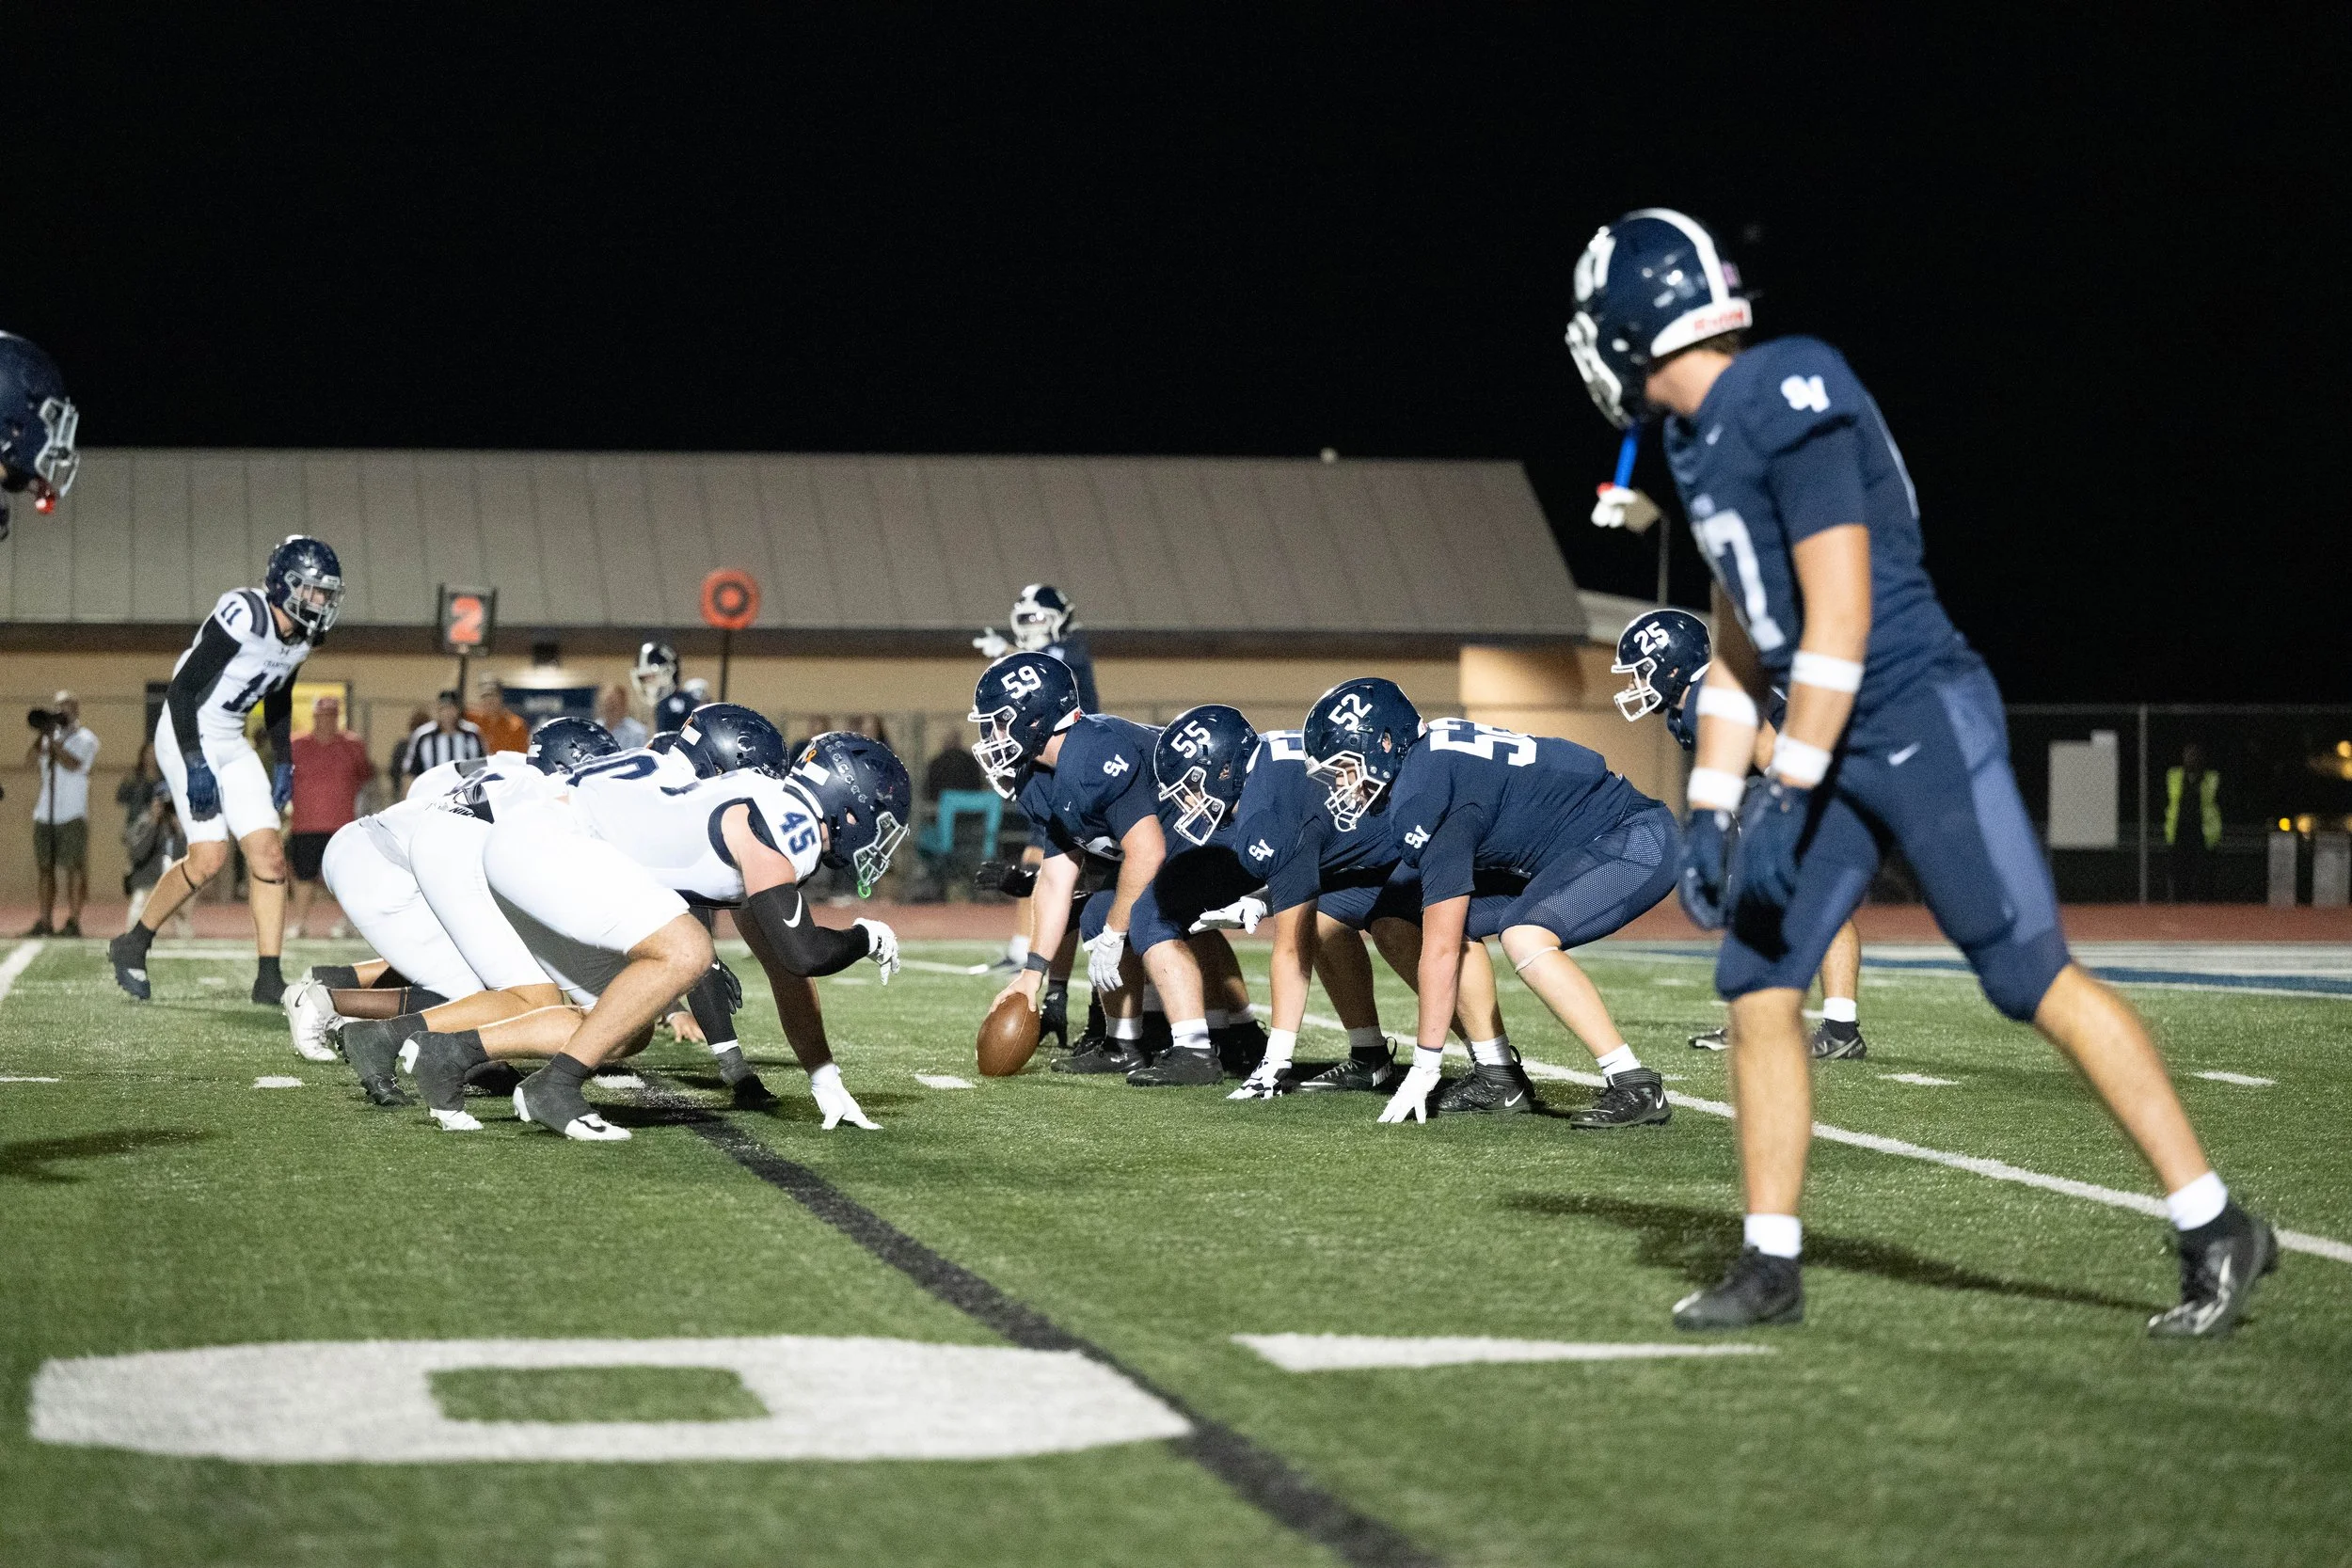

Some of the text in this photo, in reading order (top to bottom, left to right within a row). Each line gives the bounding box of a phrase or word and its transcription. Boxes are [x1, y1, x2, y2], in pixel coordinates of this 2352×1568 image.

[220, 601, 242, 626] 11
[449, 595, 483, 643] 2
[1633, 621, 1670, 656] 25
[1000, 665, 1041, 700] 59
[1327, 693, 1374, 732] 52
[1170, 720, 1211, 759] 55
[1103, 753, 1129, 777] SV
[449, 806, 476, 818] NIK
[779, 811, 817, 856] 45
[1248, 839, 1275, 862] SV
[1405, 824, 1432, 849] SV
